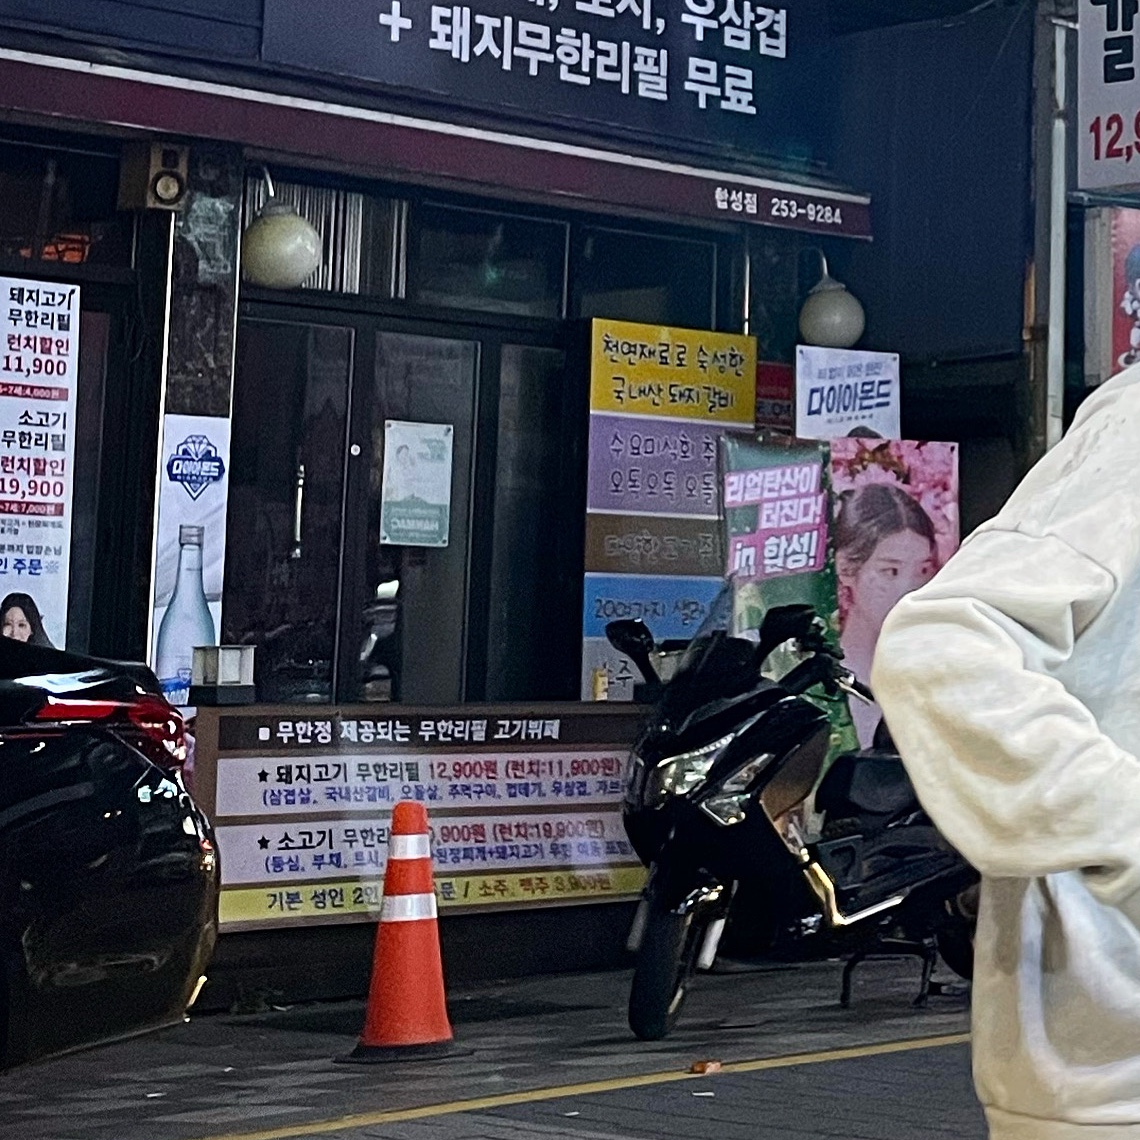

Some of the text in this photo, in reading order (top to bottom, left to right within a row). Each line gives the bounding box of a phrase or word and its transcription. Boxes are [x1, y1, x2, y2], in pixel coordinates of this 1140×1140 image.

[680, 0, 787, 58] 우삼겹
[428, 4, 669, 101] 돼지무한리필
[684, 56, 757, 115] 무료
[714, 187, 843, 224] 합성점 253-9284
[9, 287, 76, 310] 돼지고기
[8, 308, 71, 331] 무한리필
[7, 333, 70, 355] 런치할인
[603, 334, 745, 377] 천연재료로 숙성한
[2, 355, 67, 377] 11,900
[612, 376, 665, 406] 국내산
[669, 383, 736, 413] 돼지갈비
[807, 379, 892, 416] 다이아몬드
[18, 410, 67, 429] 소고기
[1, 430, 66, 451] 무한리필
[611, 431, 695, 462] 수요미식회
[0, 478, 64, 499] 19,900
[726, 464, 819, 502] 리얼탄산이
[760, 494, 822, 530] 터진다!
[13, 558, 43, 576] 주문
[734, 542, 756, 577] in
[276, 720, 332, 743] 무한정
[340, 720, 411, 743] 제공되는
[418, 719, 487, 742] 무한리필
[276, 763, 348, 784] 돼지고기
[356, 761, 419, 782] 무한리필
[429, 760, 498, 781] 12,900원
[277, 829, 334, 850] 소고기
[342, 826, 391, 847] 무한리
[267, 891, 303, 911] 기본
[310, 888, 344, 910] 성인
